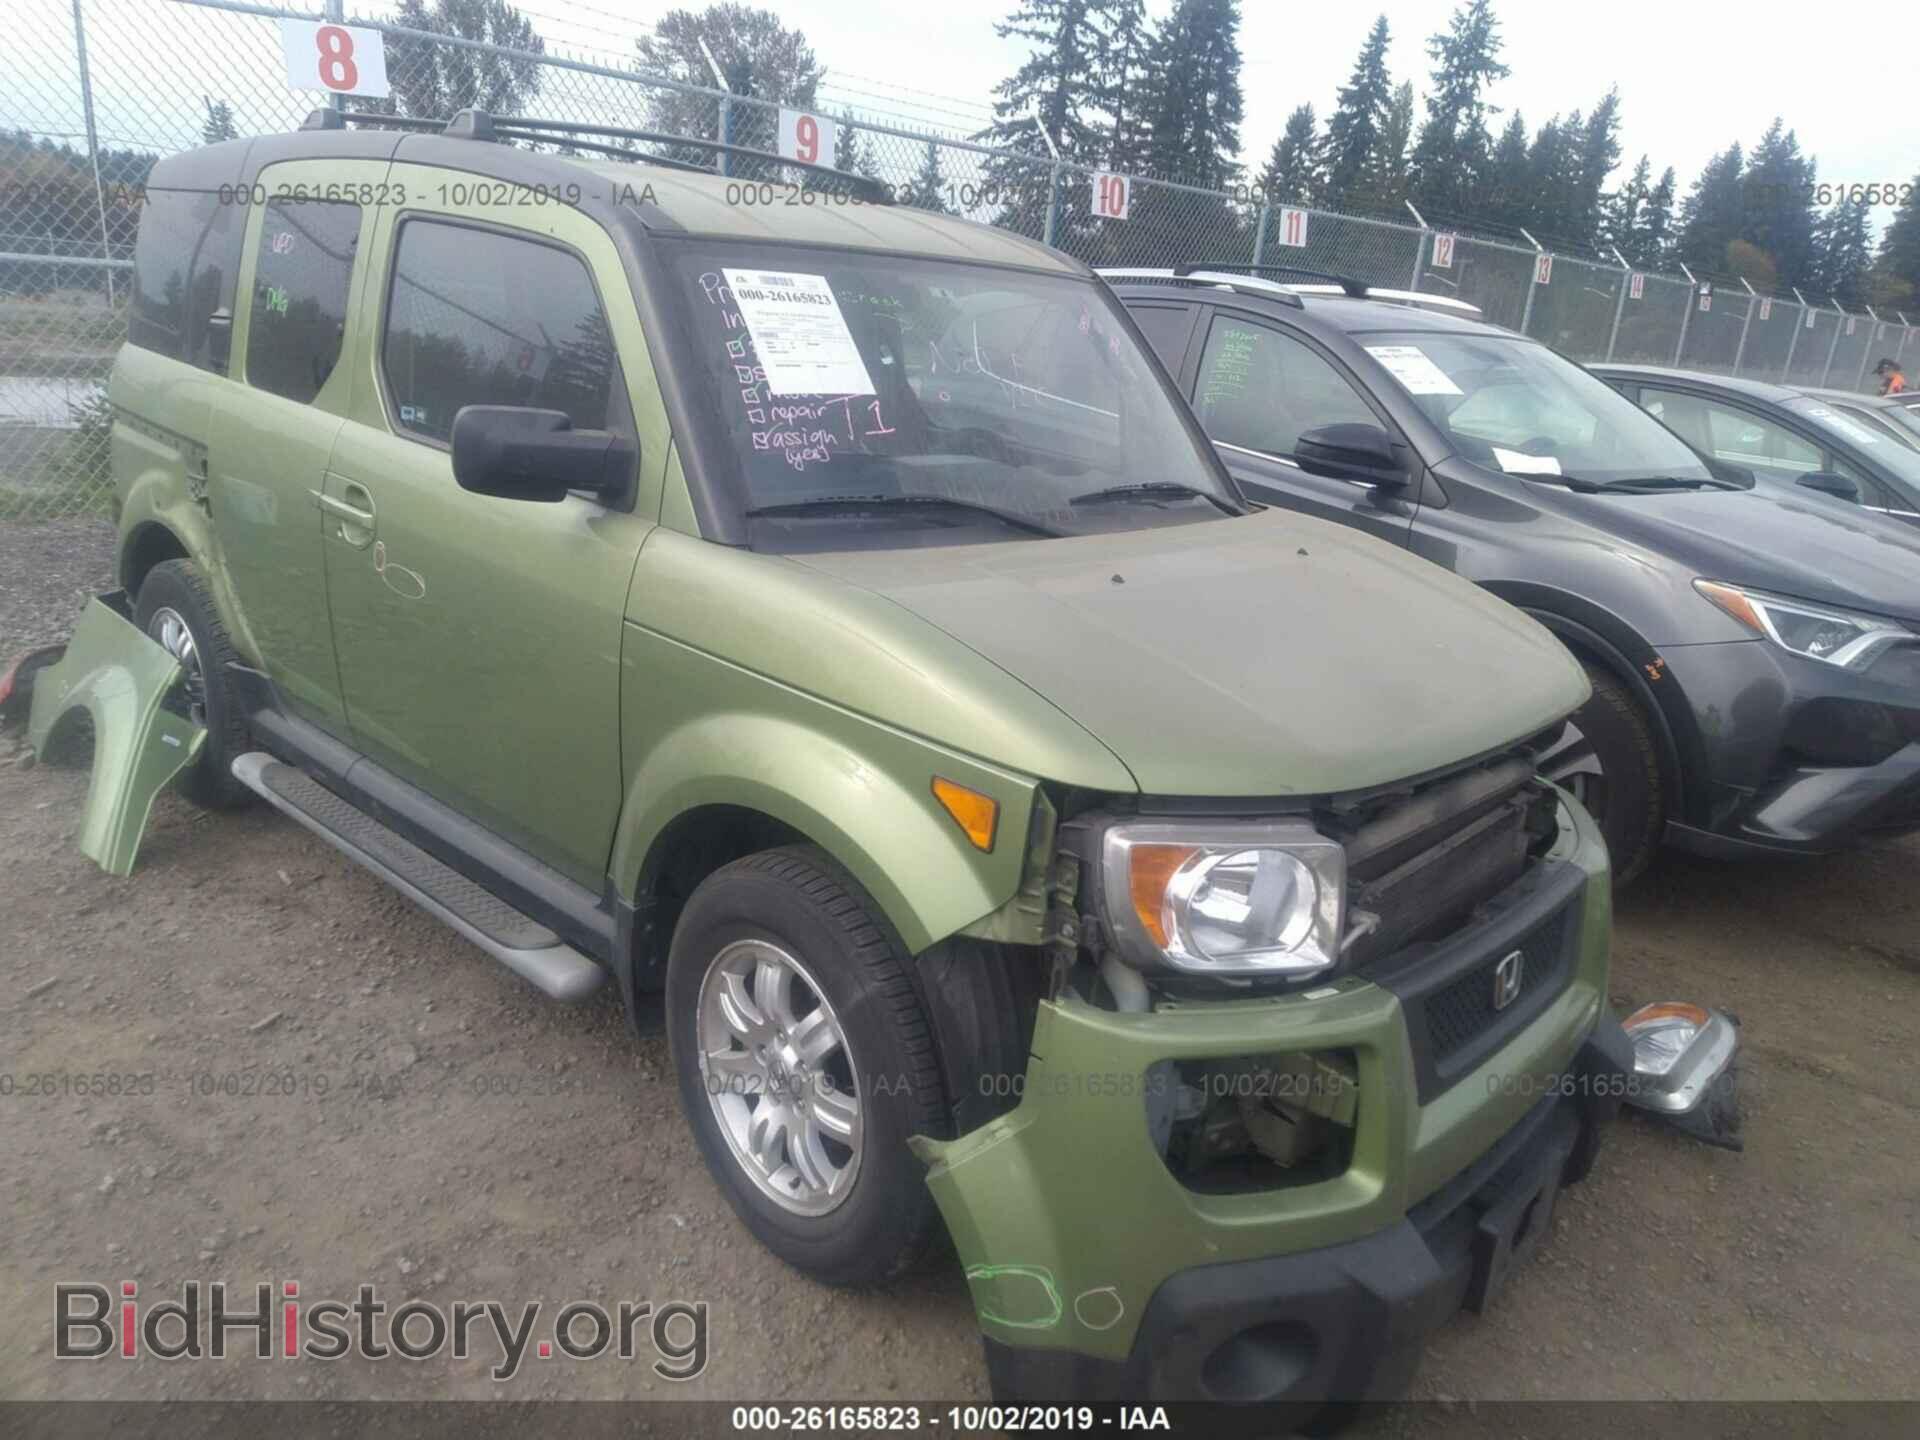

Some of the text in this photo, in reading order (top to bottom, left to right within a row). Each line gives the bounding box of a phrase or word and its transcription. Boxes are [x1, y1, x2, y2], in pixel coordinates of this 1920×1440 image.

[316, 26, 357, 91] 8
[796, 116, 820, 163] 9
[1099, 175, 1124, 216] 10
[1288, 211, 1301, 244] 11
[1437, 238, 1450, 265] 12
[738, 288, 832, 306] 000-26165823
[771, 402, 828, 426] repair
[772, 427, 838, 450] assign
